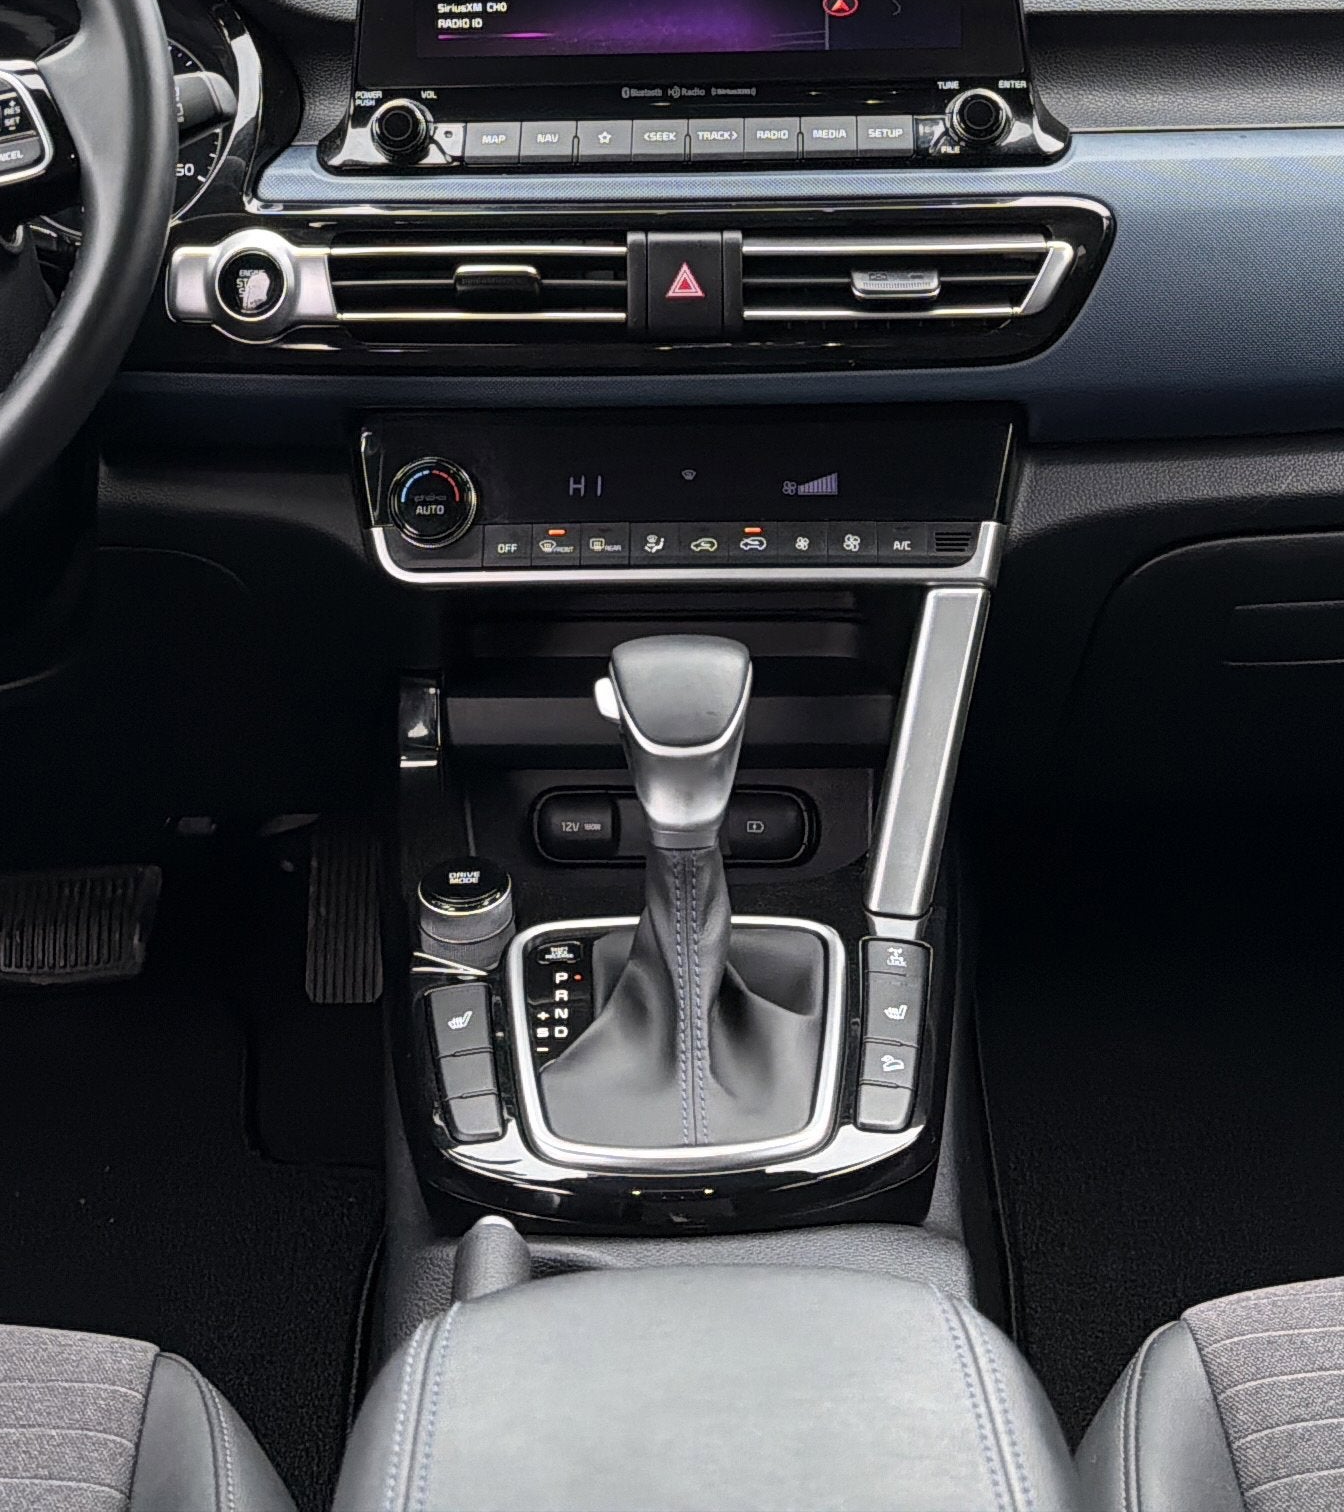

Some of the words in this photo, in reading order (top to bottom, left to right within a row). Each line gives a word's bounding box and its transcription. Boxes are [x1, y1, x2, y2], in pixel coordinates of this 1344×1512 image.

[437, 2, 483, 13] SiriusXM
[437, 18, 470, 29] RADIO
[472, 17, 483, 28] ID
[937, 80, 960, 89] TUNE
[998, 79, 1027, 89] ENTER
[355, 90, 383, 99] POWER
[420, 90, 438, 99] VOL
[355, 99, 376, 107] PUSH
[3, 105, 21, 116] RES
[4, 116, 21, 127] SET
[536, 133, 559, 144] NAV
[756, 130, 789, 140] RADIO
[812, 129, 847, 139] MEDIA
[867, 128, 903, 138] SETUP
[481, 134, 506, 144] MAP
[415, 504, 445, 516] AUTO
[497, 543, 518, 554] OFF
[893, 540, 912, 551] A/C
[560, 821, 580, 832] 12V
[448, 870, 480, 879] DRIVE
[449, 877, 479, 885] MODE
[554, 971, 569, 985] P
[554, 989, 569, 1002] R
[554, 1008, 569, 1020] N
[536, 1027, 549, 1038] S
[554, 1025, 569, 1038] D
